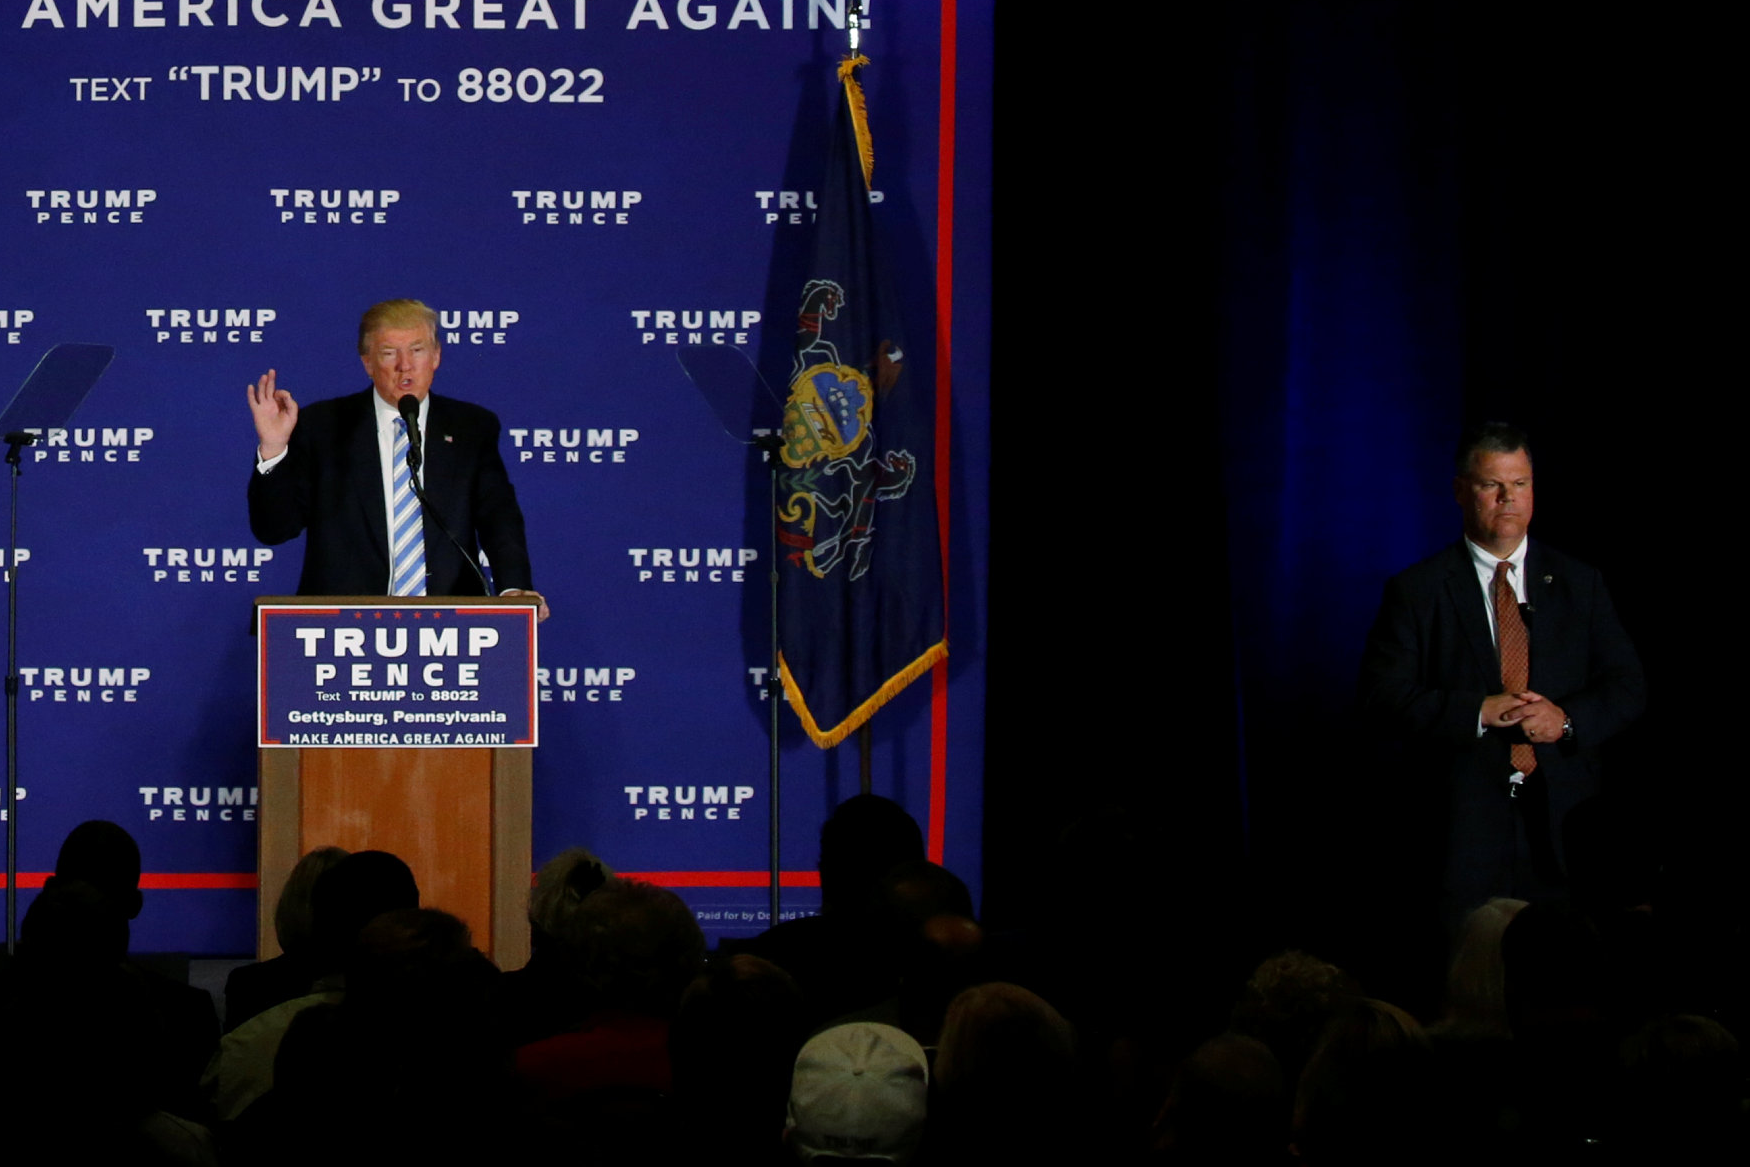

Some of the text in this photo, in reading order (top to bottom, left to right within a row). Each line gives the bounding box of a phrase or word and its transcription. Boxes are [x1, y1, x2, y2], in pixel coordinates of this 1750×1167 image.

[70, 66, 603, 102] TEXT “TRUMP” TO 88022
[26, 190, 156, 208] TRUMP
[270, 189, 400, 208] TRUMP
[512, 191, 642, 209] TRUMP
[754, 190, 885, 210] TRUP
[37, 212, 143, 223] PENCE
[281, 211, 386, 224] PENCE
[523, 213, 628, 224] PENCE
[146, 309, 276, 327] TRUMP
[440, 310, 520, 329] UMP
[631, 311, 761, 329] TRUMP
[157, 331, 262, 343] PENCE
[446, 332, 507, 344] NCE
[643, 332, 747, 344] PENCE
[509, 429, 639, 447] TRUMP
[35, 450, 140, 462] PENCE
[520, 451, 625, 463] PENCE
[143, 548, 273, 567] TRUMP
[629, 549, 757, 567] TRUMP
[154, 570, 259, 582] PENCE
[640, 570, 744, 582] PENCE
[296, 628, 498, 657] TRUMP
[19, 667, 150, 686] TRUMP
[316, 663, 478, 686] PENCE
[538, 668, 636, 686] RUMP
[31, 690, 137, 702] PENCE
[316, 691, 478, 701] Text TRUMP to 88022
[540, 689, 622, 702] ENCE
[289, 711, 506, 725] Gettysburg, Pennsylvania
[290, 734, 504, 744] MAKE AMERICA GREAT AGAIN!
[625, 786, 754, 805] TRUMP
[149, 809, 255, 821] PENCE
[635, 808, 740, 820] PENCE
[697, 912, 720, 920] Paid
[724, 912, 738, 920] for
[742, 912, 754, 921] by
[758, 912, 795, 920] Doald
